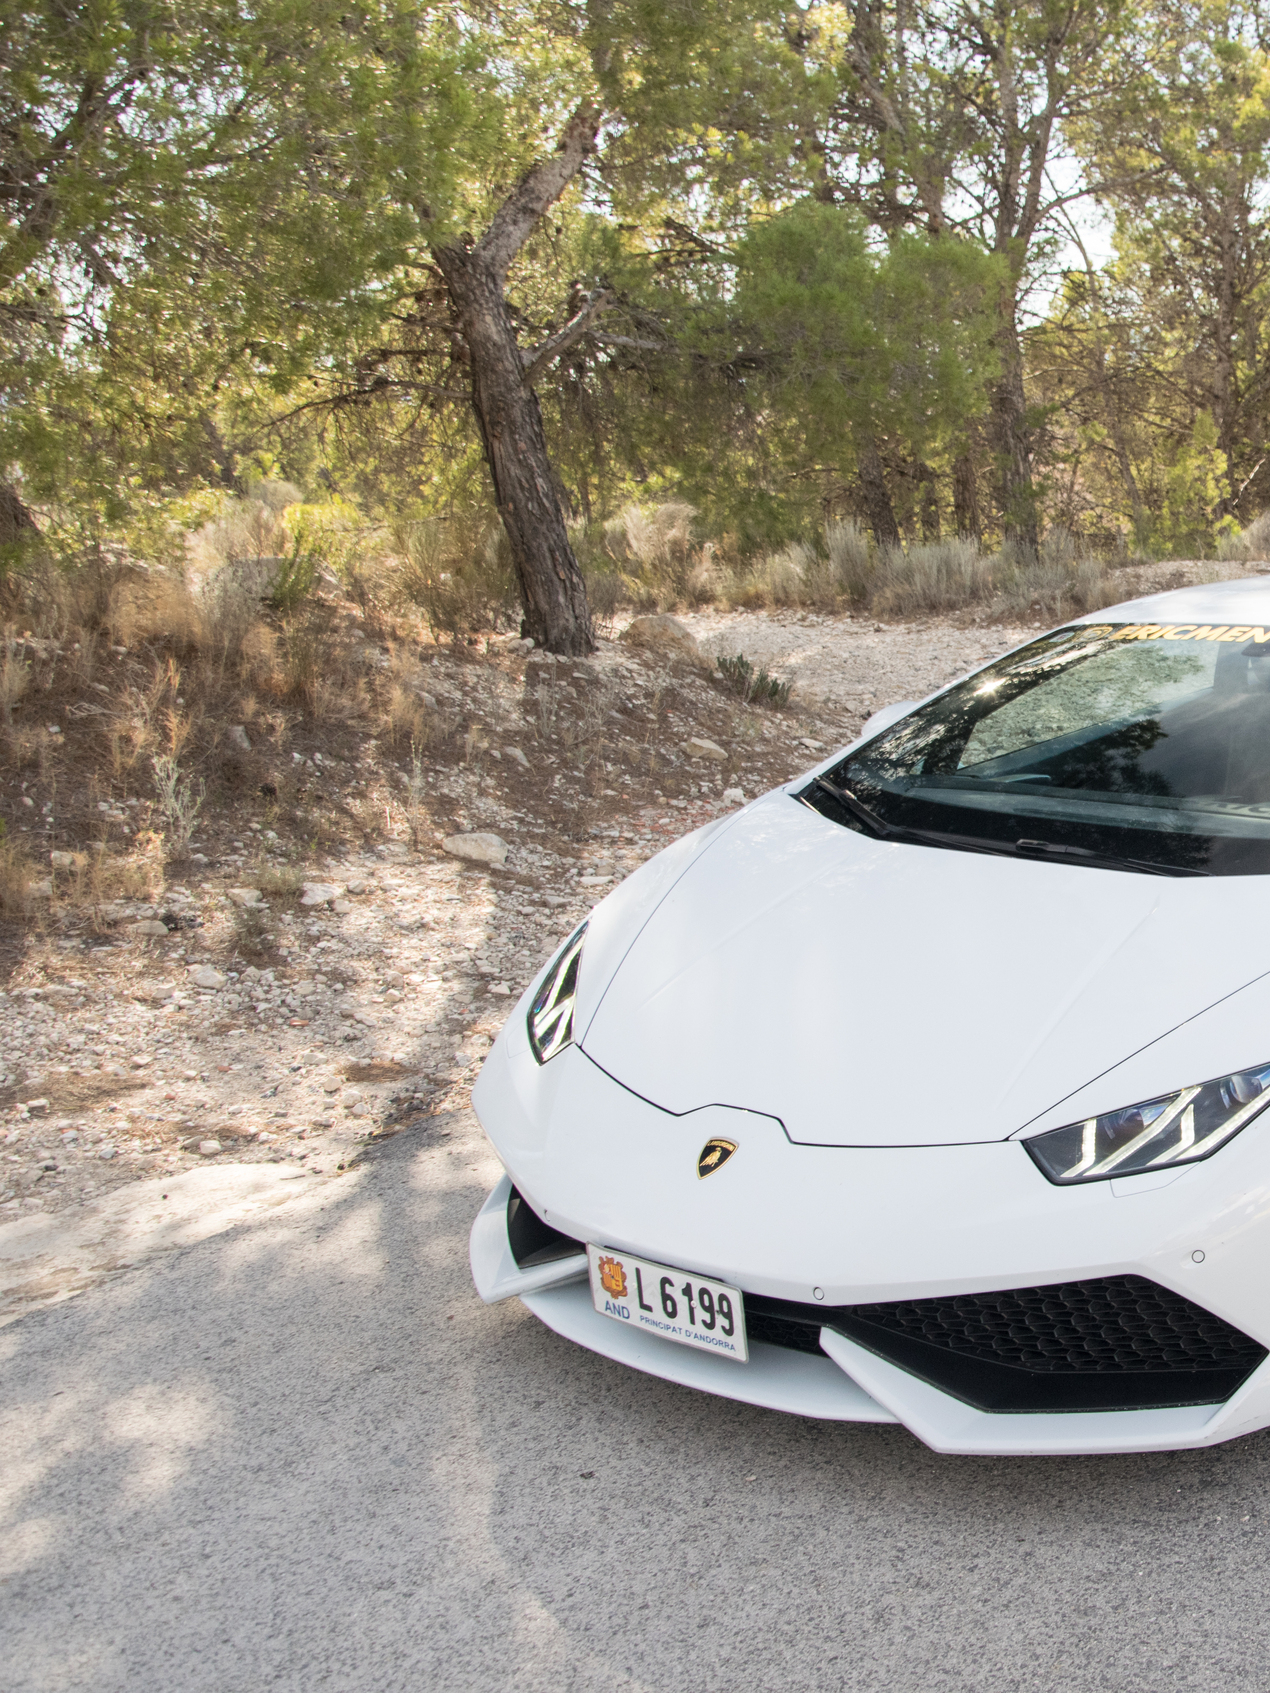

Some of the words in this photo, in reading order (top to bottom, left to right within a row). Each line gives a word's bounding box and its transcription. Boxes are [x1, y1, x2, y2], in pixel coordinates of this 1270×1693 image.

[605, 1300, 630, 1319] AND
[635, 1267, 653, 1312] L
[660, 1276, 735, 1337] 6199
[639, 1315, 683, 1335] PRINCIPAT
[684, 1330, 737, 1352] D'ANDORRA
